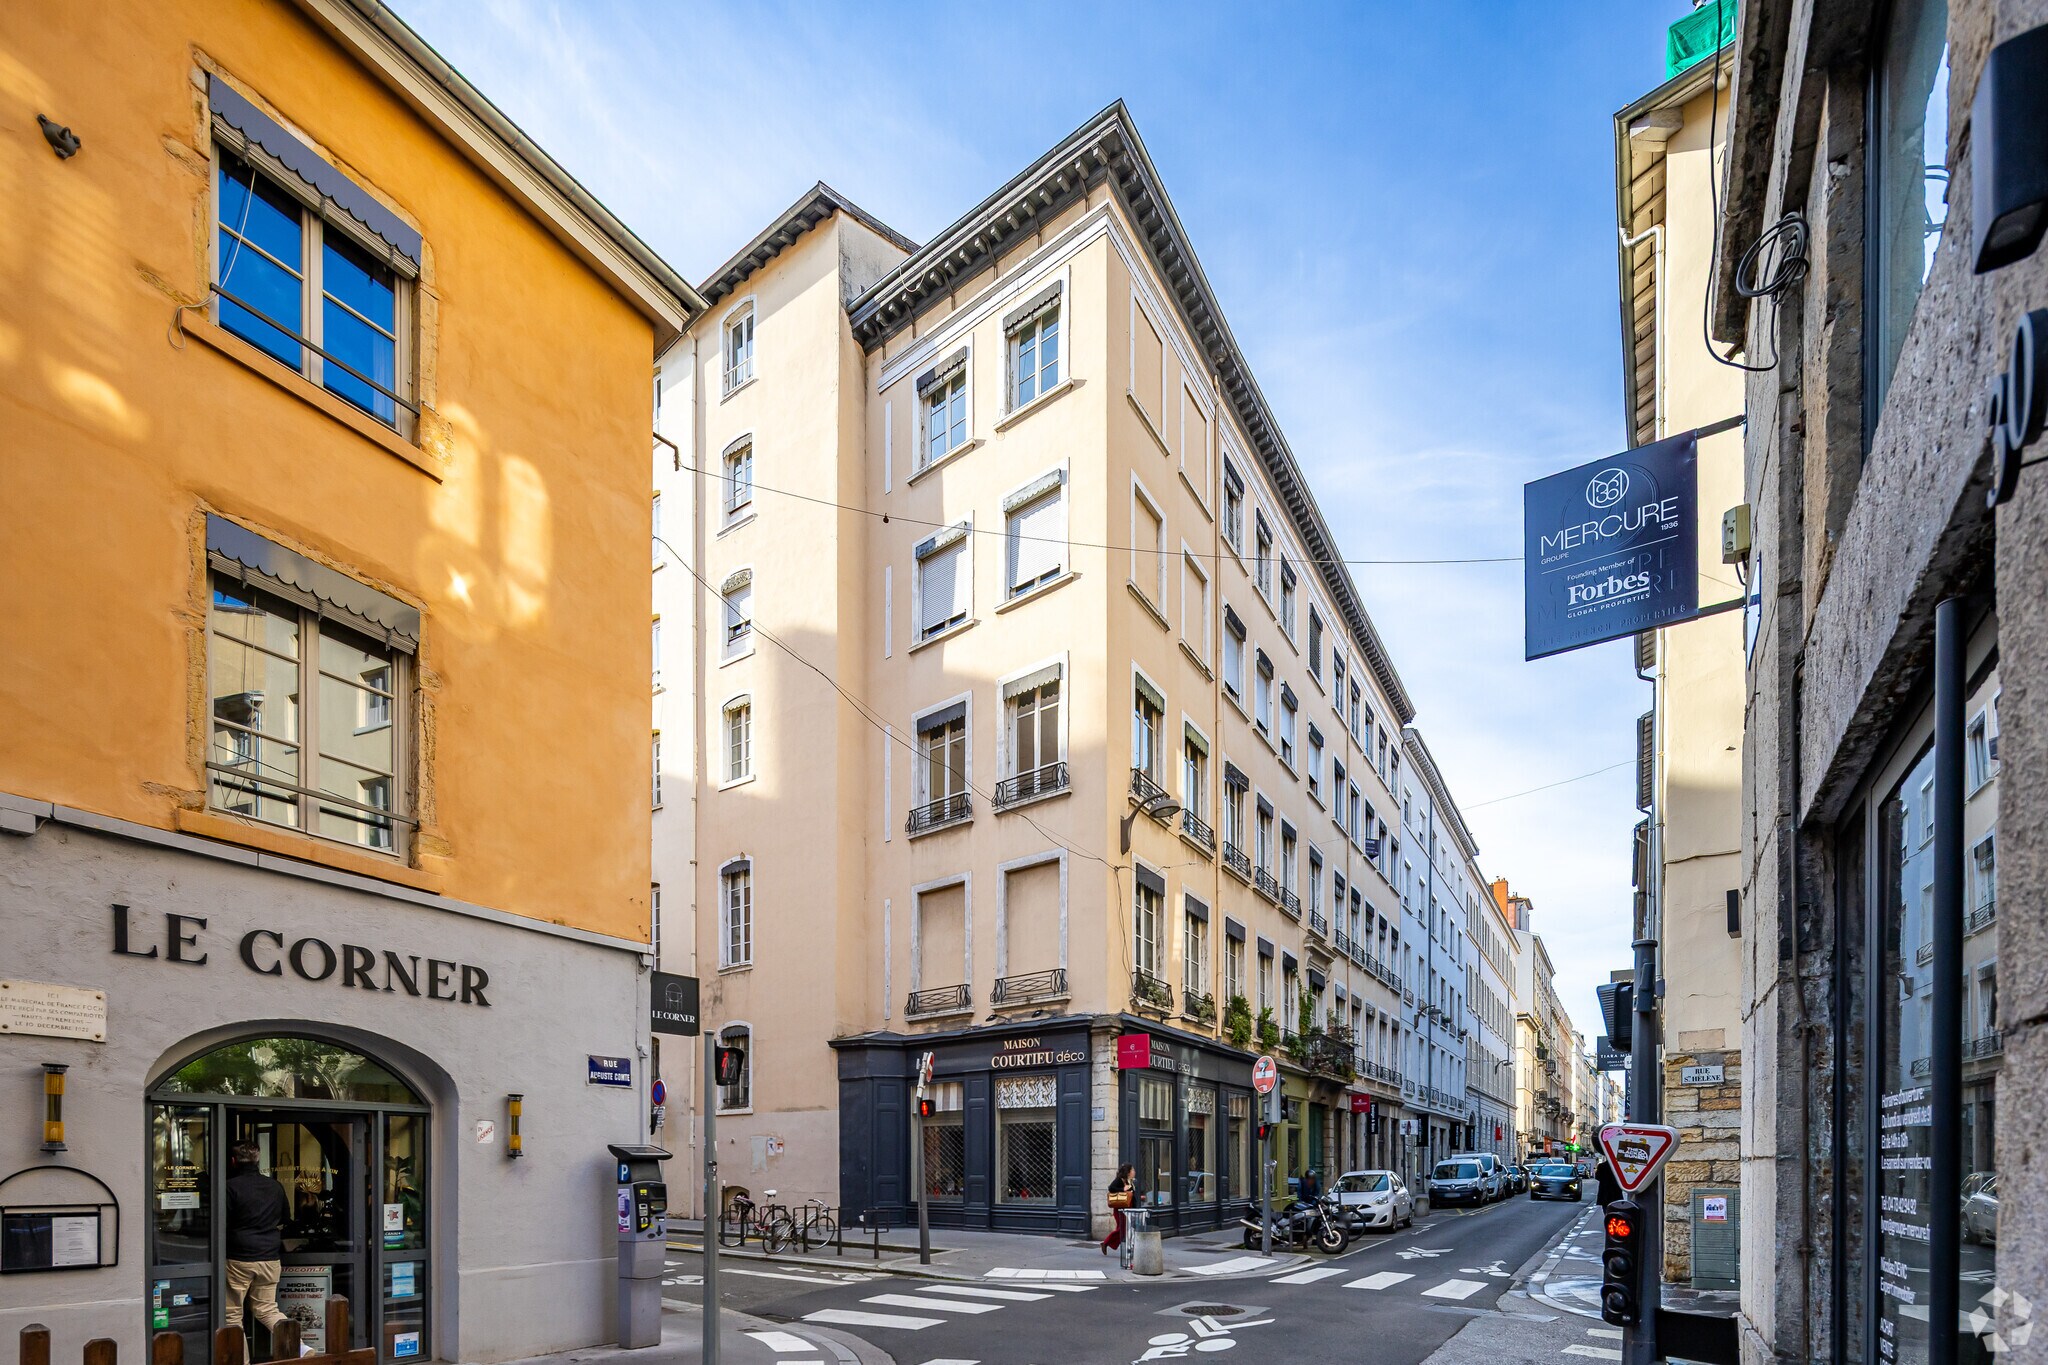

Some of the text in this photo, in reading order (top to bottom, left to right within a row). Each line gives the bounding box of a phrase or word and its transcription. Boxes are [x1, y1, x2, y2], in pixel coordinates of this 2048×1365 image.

[1541, 496, 1678, 556] MERCURE
[1660, 521, 1679, 531] 1936
[1541, 552, 1570, 565] GROUPE
[1567, 556, 1636, 581] Founding Member of
[1568, 571, 1650, 606] Forbes
[1568, 593, 1650, 618] GLOBAL PROPERTIES
[112, 904, 492, 1007] LE CORNER
[60, 1010, 104, 1019] COMPATRIOTES
[652, 1010, 695, 1023] LE CORNER
[1004, 1038, 1041, 1050] MAISON
[1151, 1040, 1170, 1052] MAISON
[604, 1060, 618, 1068] RUE
[991, 1050, 1085, 1068] COURTIEU déco
[1149, 1054, 1175, 1071] OURTIEU
[614, 1073, 630, 1081] COMTE
[622, 1164, 628, 1180] P
